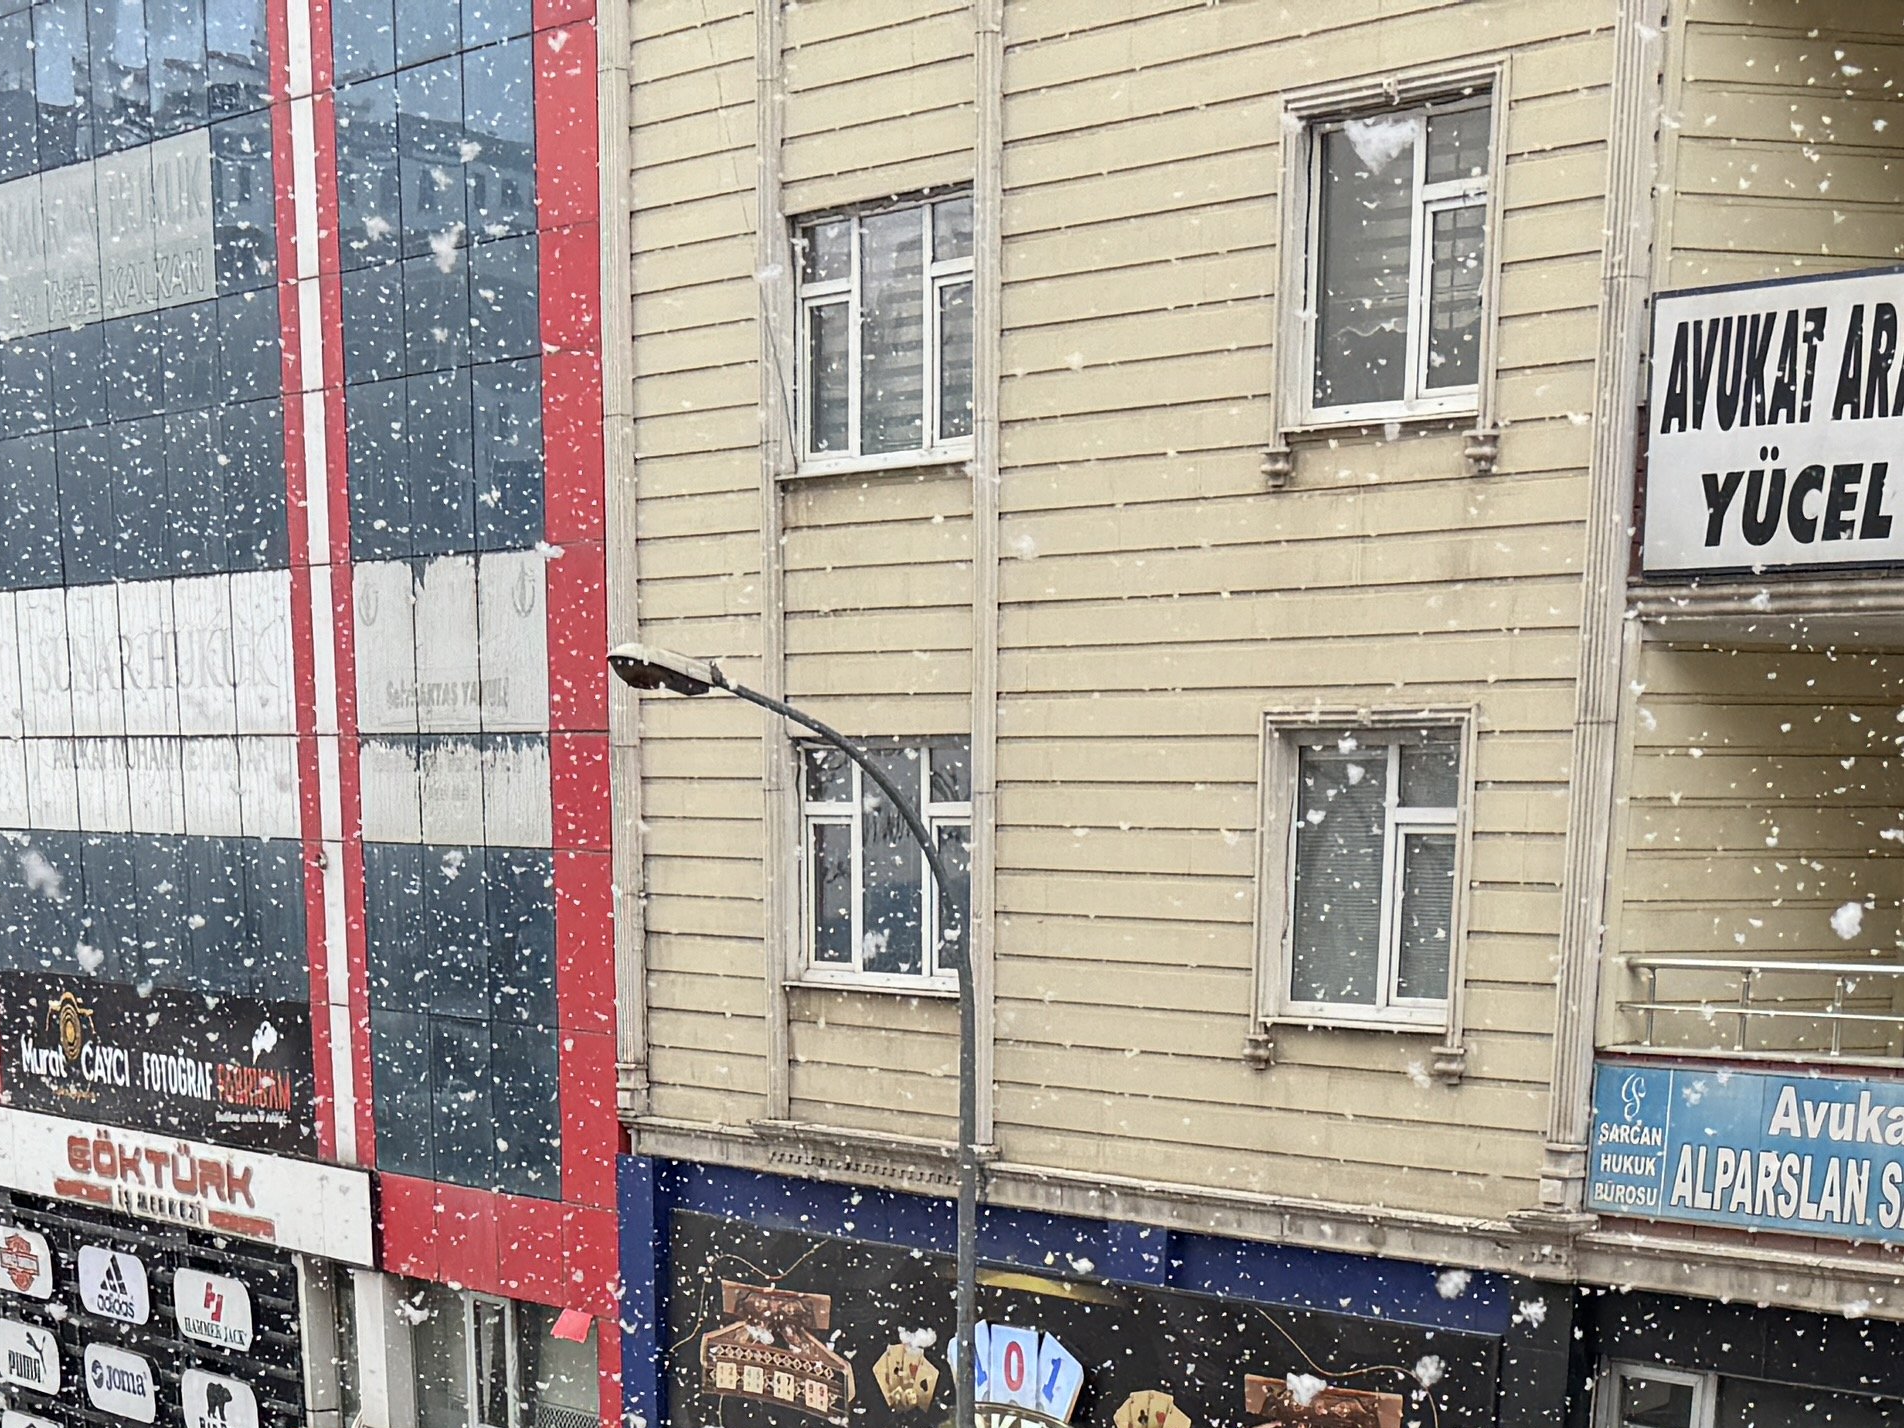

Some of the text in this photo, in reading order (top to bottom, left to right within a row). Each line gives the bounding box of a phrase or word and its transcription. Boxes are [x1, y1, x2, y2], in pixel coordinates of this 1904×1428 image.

[109, 248, 206, 311] KALKAN
[1660, 307, 1828, 434] AVUKAT
[1701, 446, 1893, 547] YÜCEL
[19, 1034, 68, 1079] Murat
[142, 1048, 214, 1101] FOTOĞRAF
[66, 1128, 256, 1209] GÖKTÜRK
[1594, 1180, 1658, 1207] BÜROSU
[1600, 1153, 1656, 1177] HUKUK
[1669, 1143, 1871, 1226] ALPARSLAN
[96, 1291, 135, 1320] adidas
